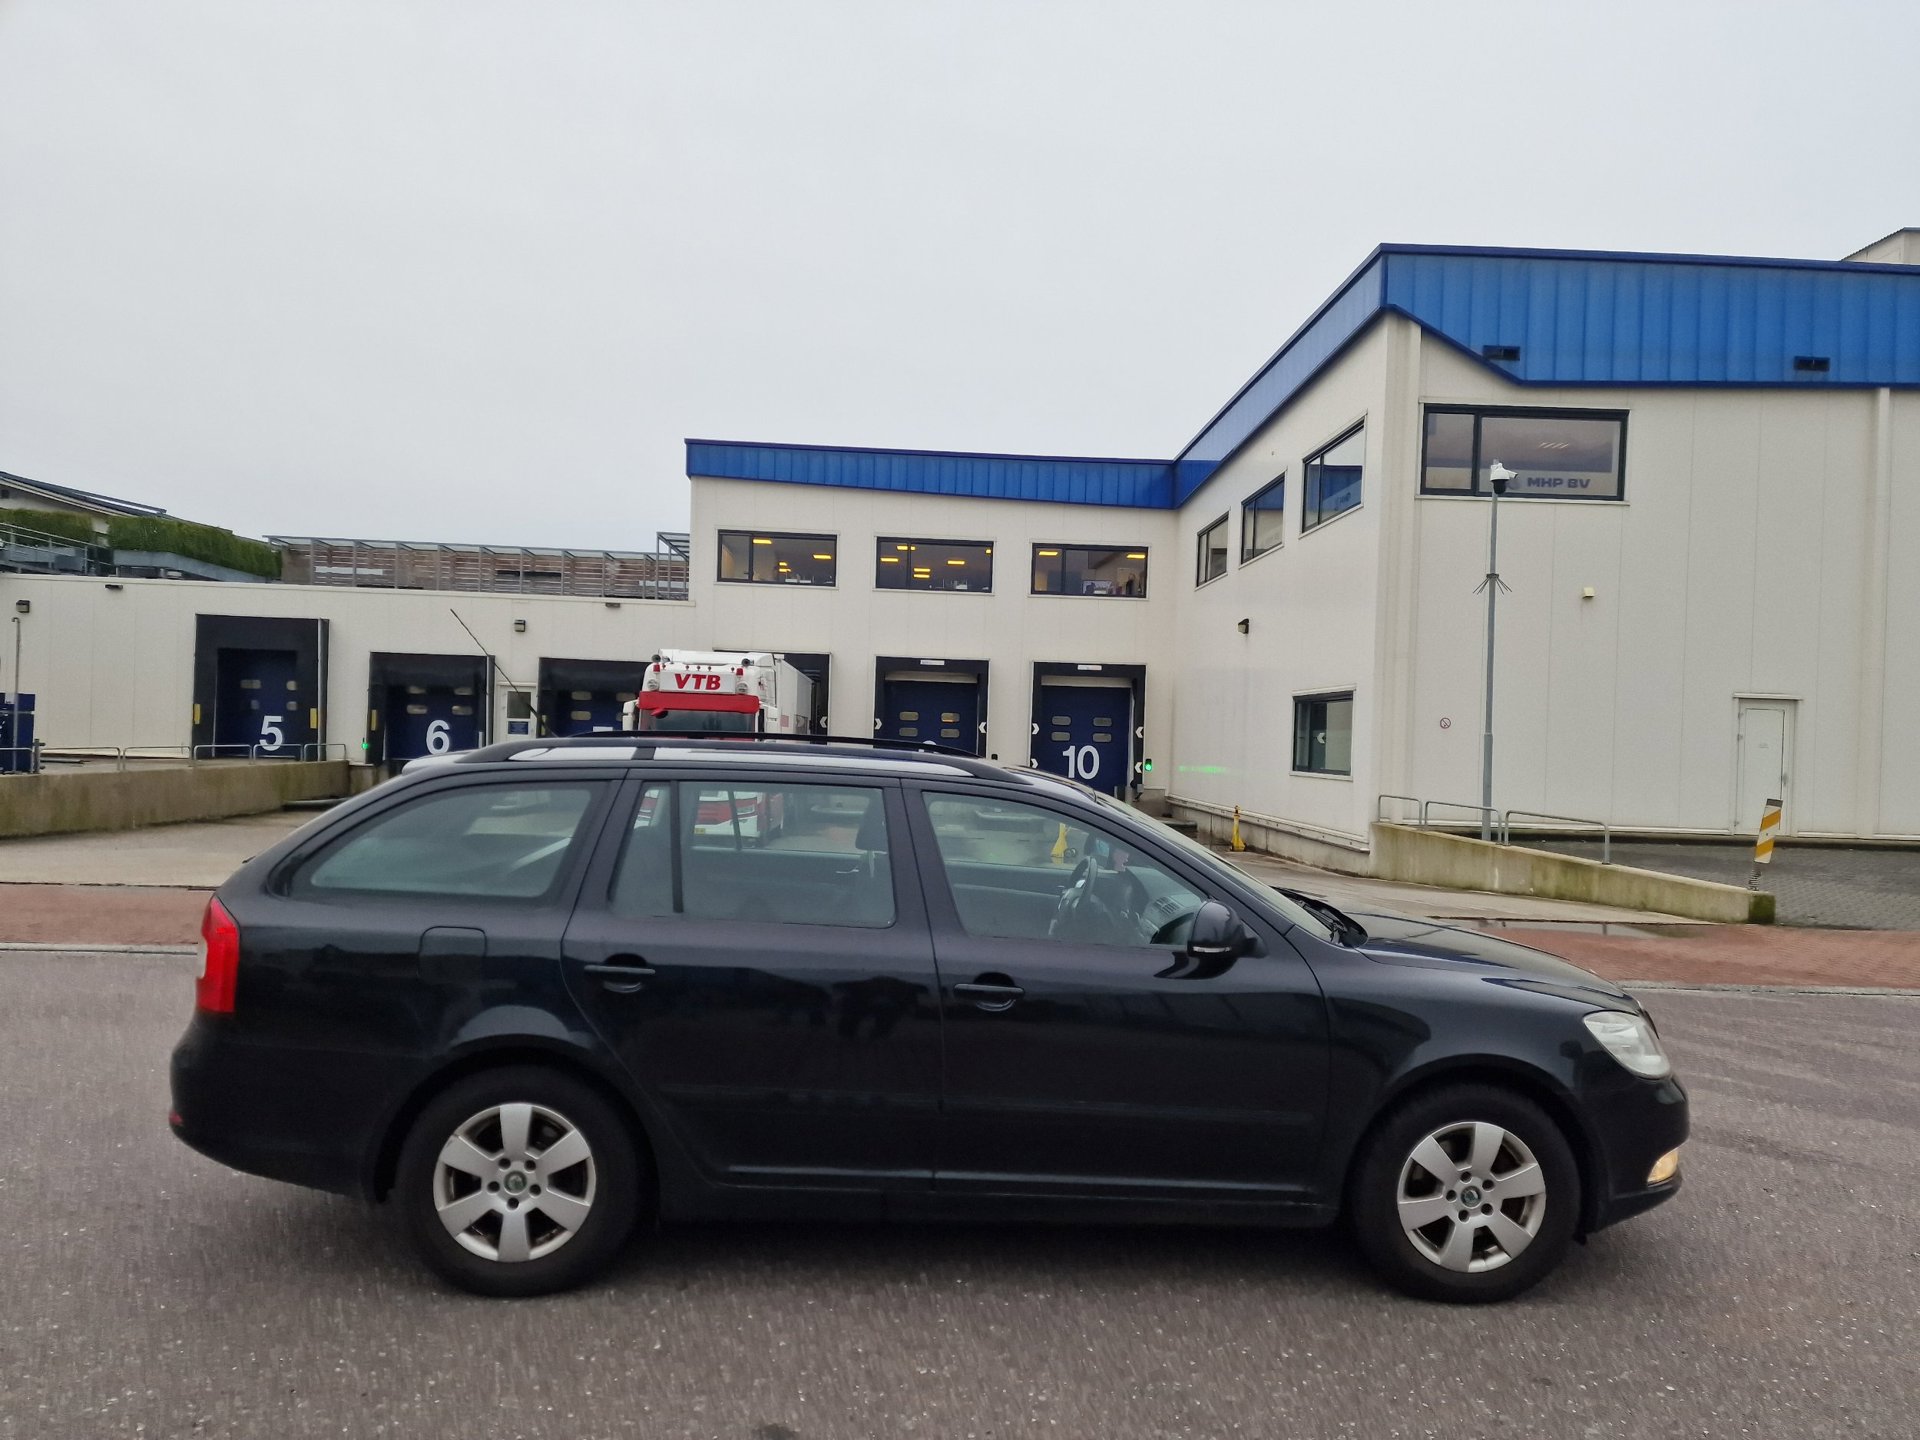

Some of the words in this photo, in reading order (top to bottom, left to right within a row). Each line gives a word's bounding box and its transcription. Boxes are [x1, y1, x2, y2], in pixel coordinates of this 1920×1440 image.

[1527, 477, 1563, 488] MHP
[1567, 478, 1591, 489] BV
[674, 673, 721, 691] VTB
[259, 715, 283, 751] 5
[425, 719, 451, 755] 6
[1062, 745, 1100, 780] 10
